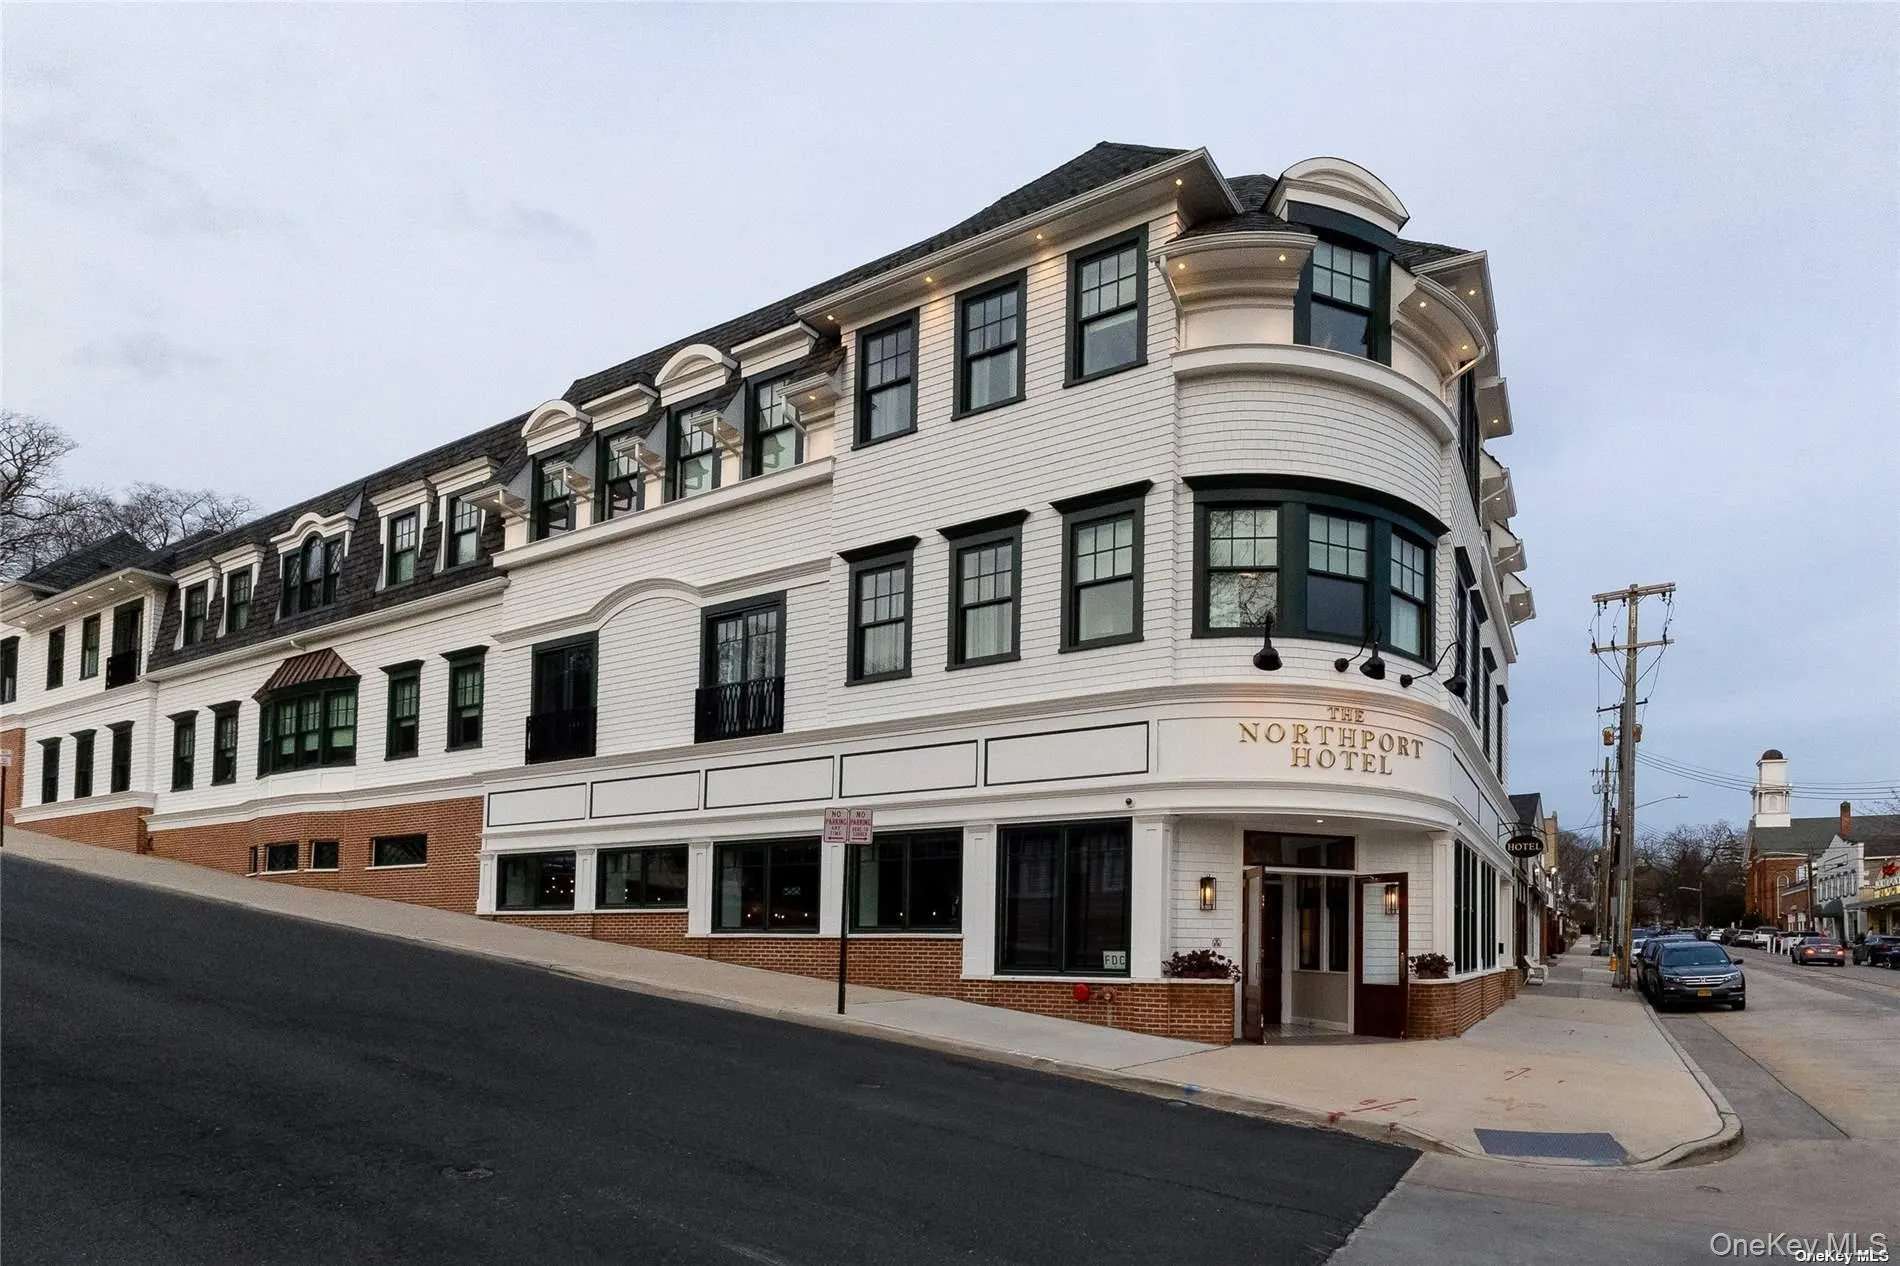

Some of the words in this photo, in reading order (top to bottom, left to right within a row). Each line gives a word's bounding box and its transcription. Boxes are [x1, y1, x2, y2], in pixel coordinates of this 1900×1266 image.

[1327, 706, 1365, 723] THE
[1238, 722, 1424, 759] NORTHPORT
[1290, 746, 1393, 775] HOTEL
[1507, 842, 1541, 851] HOTEL
[1104, 955, 1125, 965] FDC
